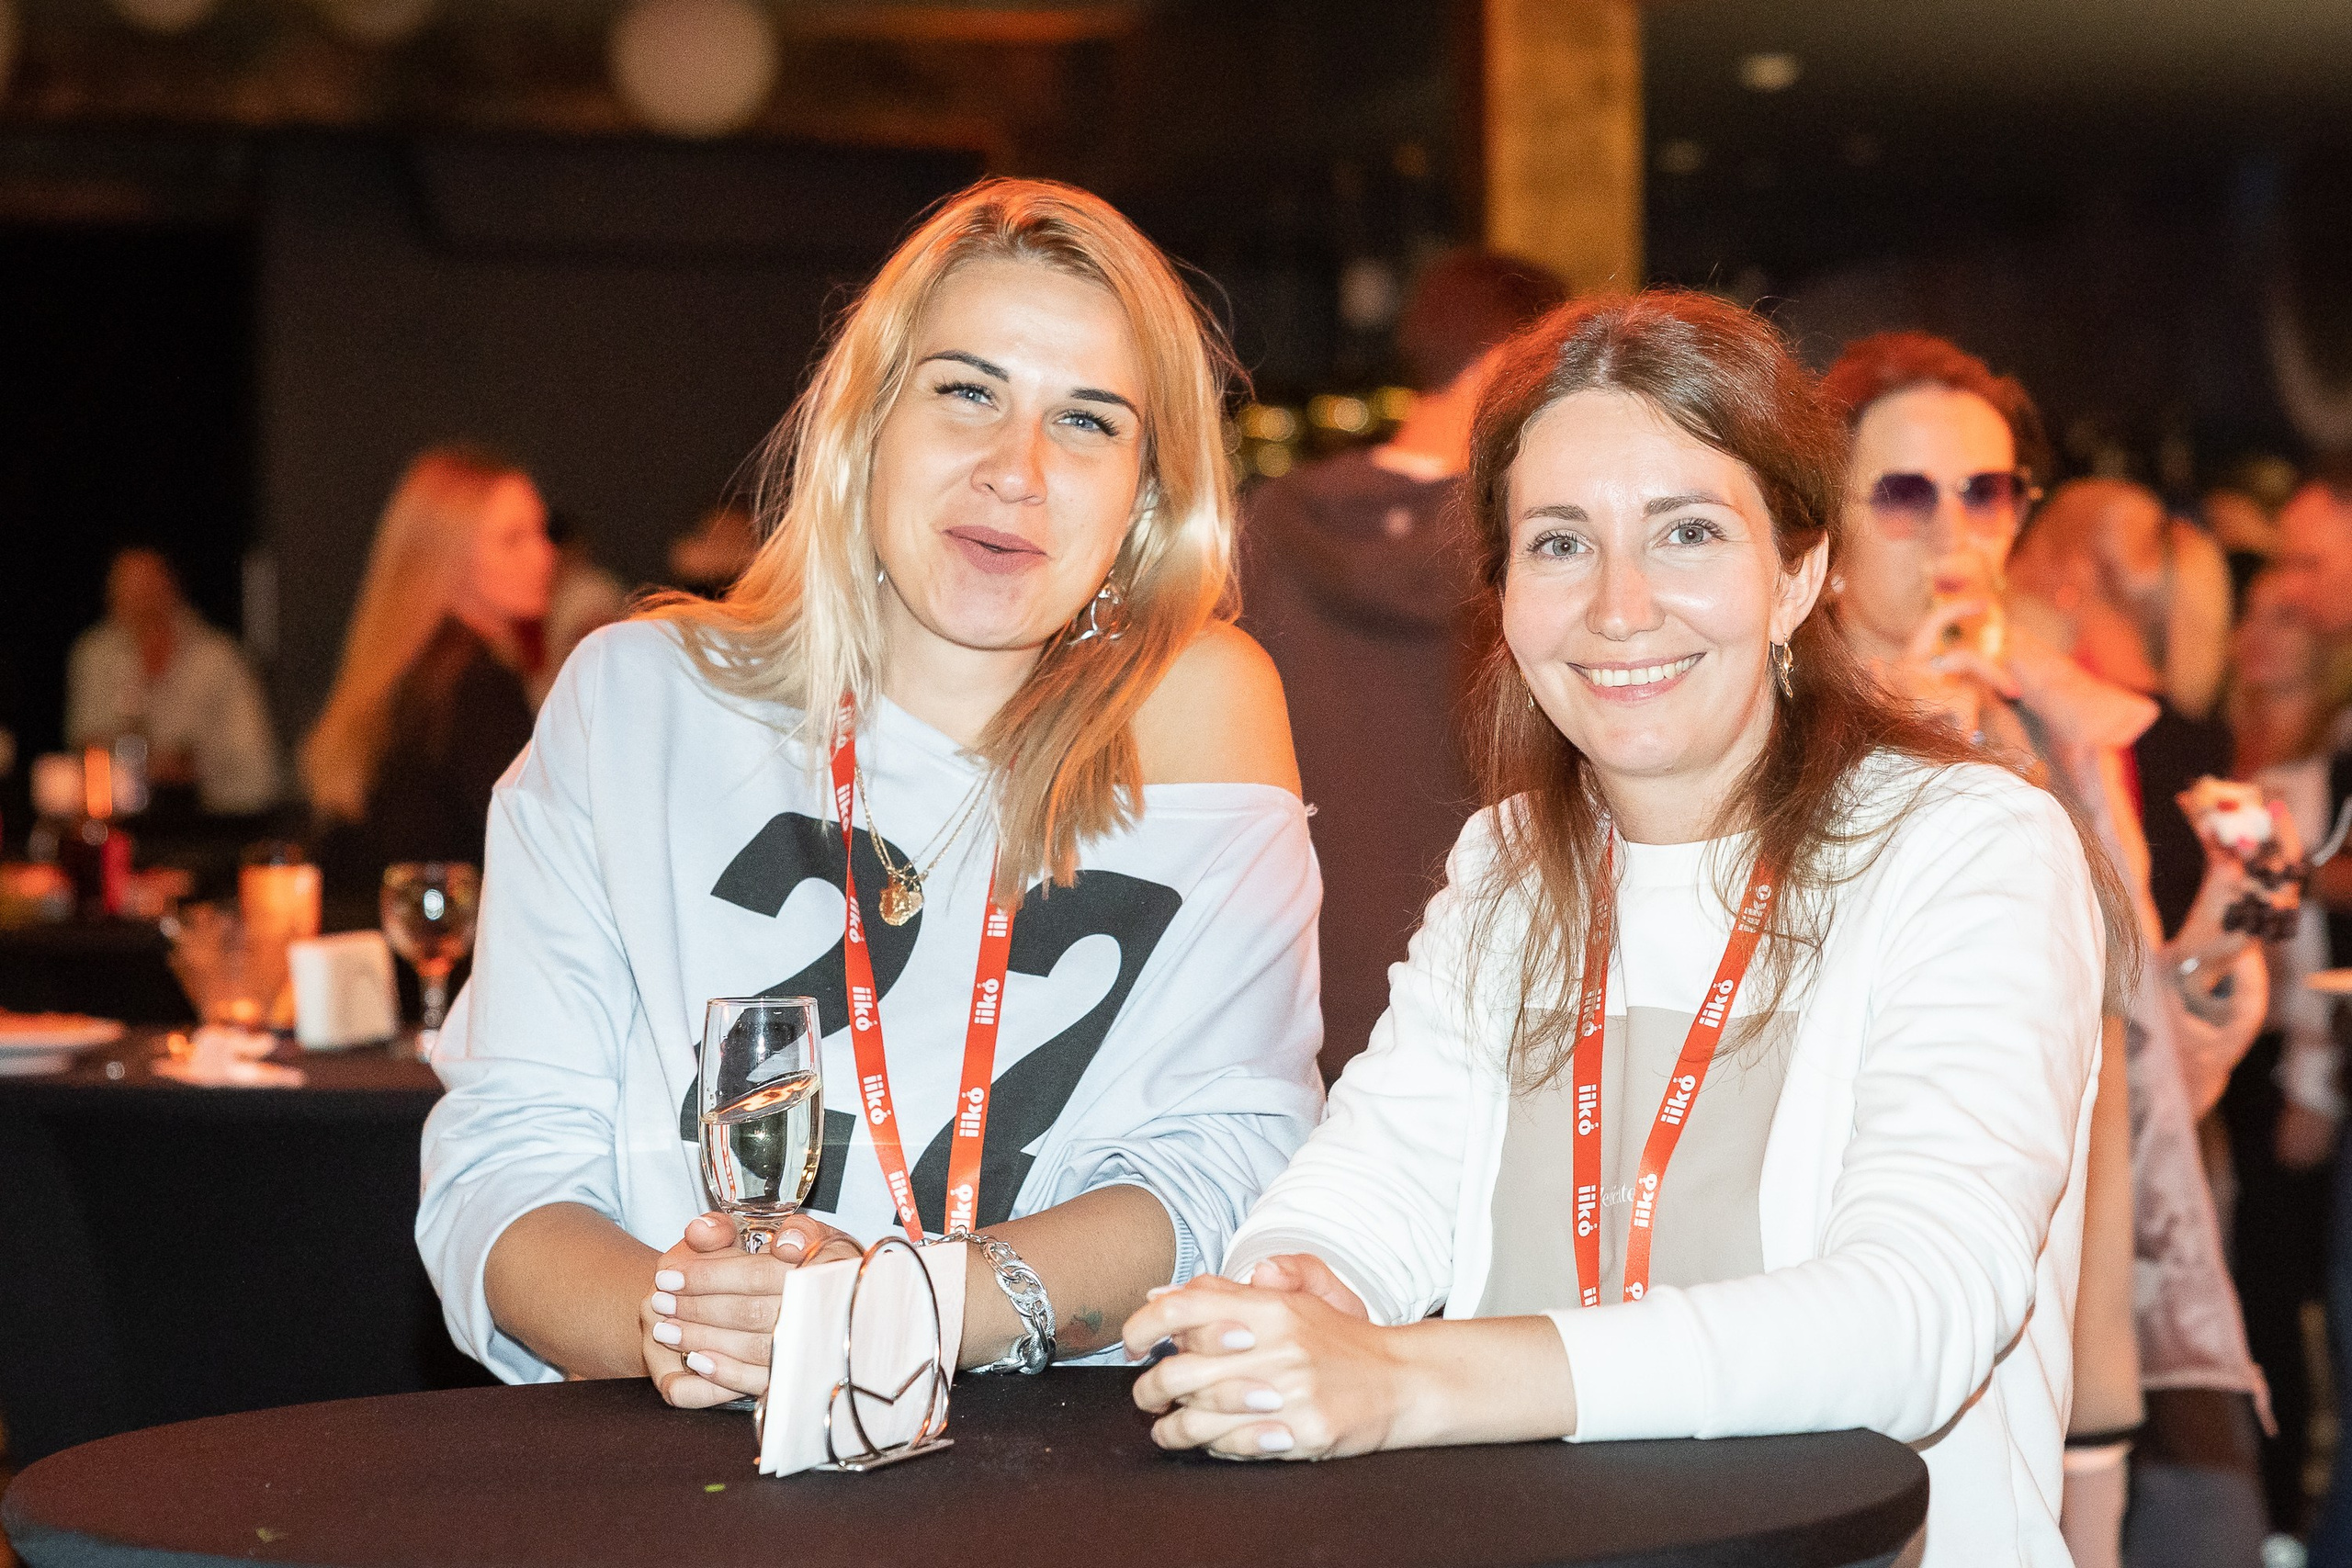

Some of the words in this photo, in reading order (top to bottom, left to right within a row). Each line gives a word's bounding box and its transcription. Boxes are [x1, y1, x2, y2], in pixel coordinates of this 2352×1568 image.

[852, 986, 877, 1032] iiko
[975, 977, 1000, 1025] iiko
[1699, 979, 1734, 1028] iiko
[863, 1074, 891, 1125] iiko
[959, 1087, 985, 1137] iiko
[1577, 1084, 1599, 1136] iiko
[1660, 1075, 1696, 1125] iiko
[888, 1170, 915, 1223] iiko
[1577, 1184, 1598, 1237] iiko
[1634, 1173, 1657, 1228] iiko
